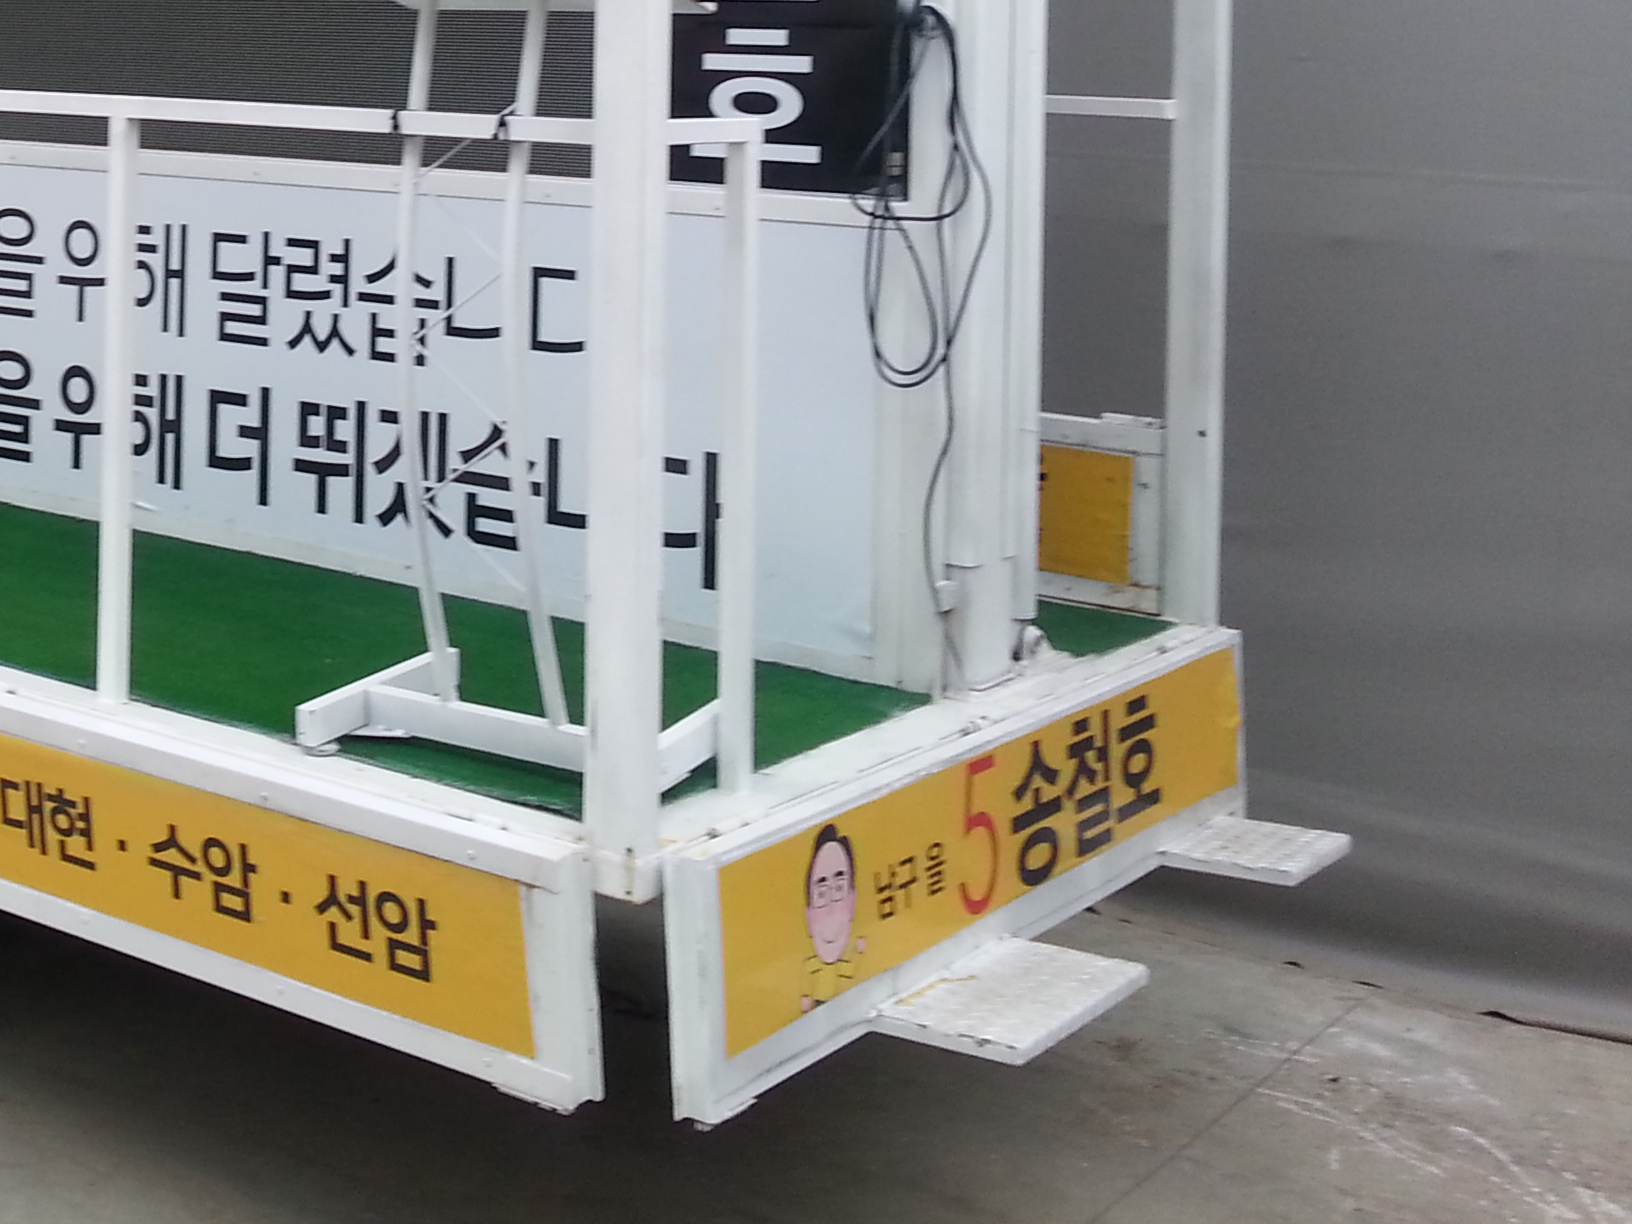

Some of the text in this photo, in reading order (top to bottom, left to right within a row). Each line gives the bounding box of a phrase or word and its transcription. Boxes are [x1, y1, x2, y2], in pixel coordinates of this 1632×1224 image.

[208, 385, 271, 507] 더
[959, 754, 1001, 915] 5
[1011, 693, 1162, 887] 송철호
[148, 823, 258, 923] 수암
[315, 873, 437, 983] 선암
